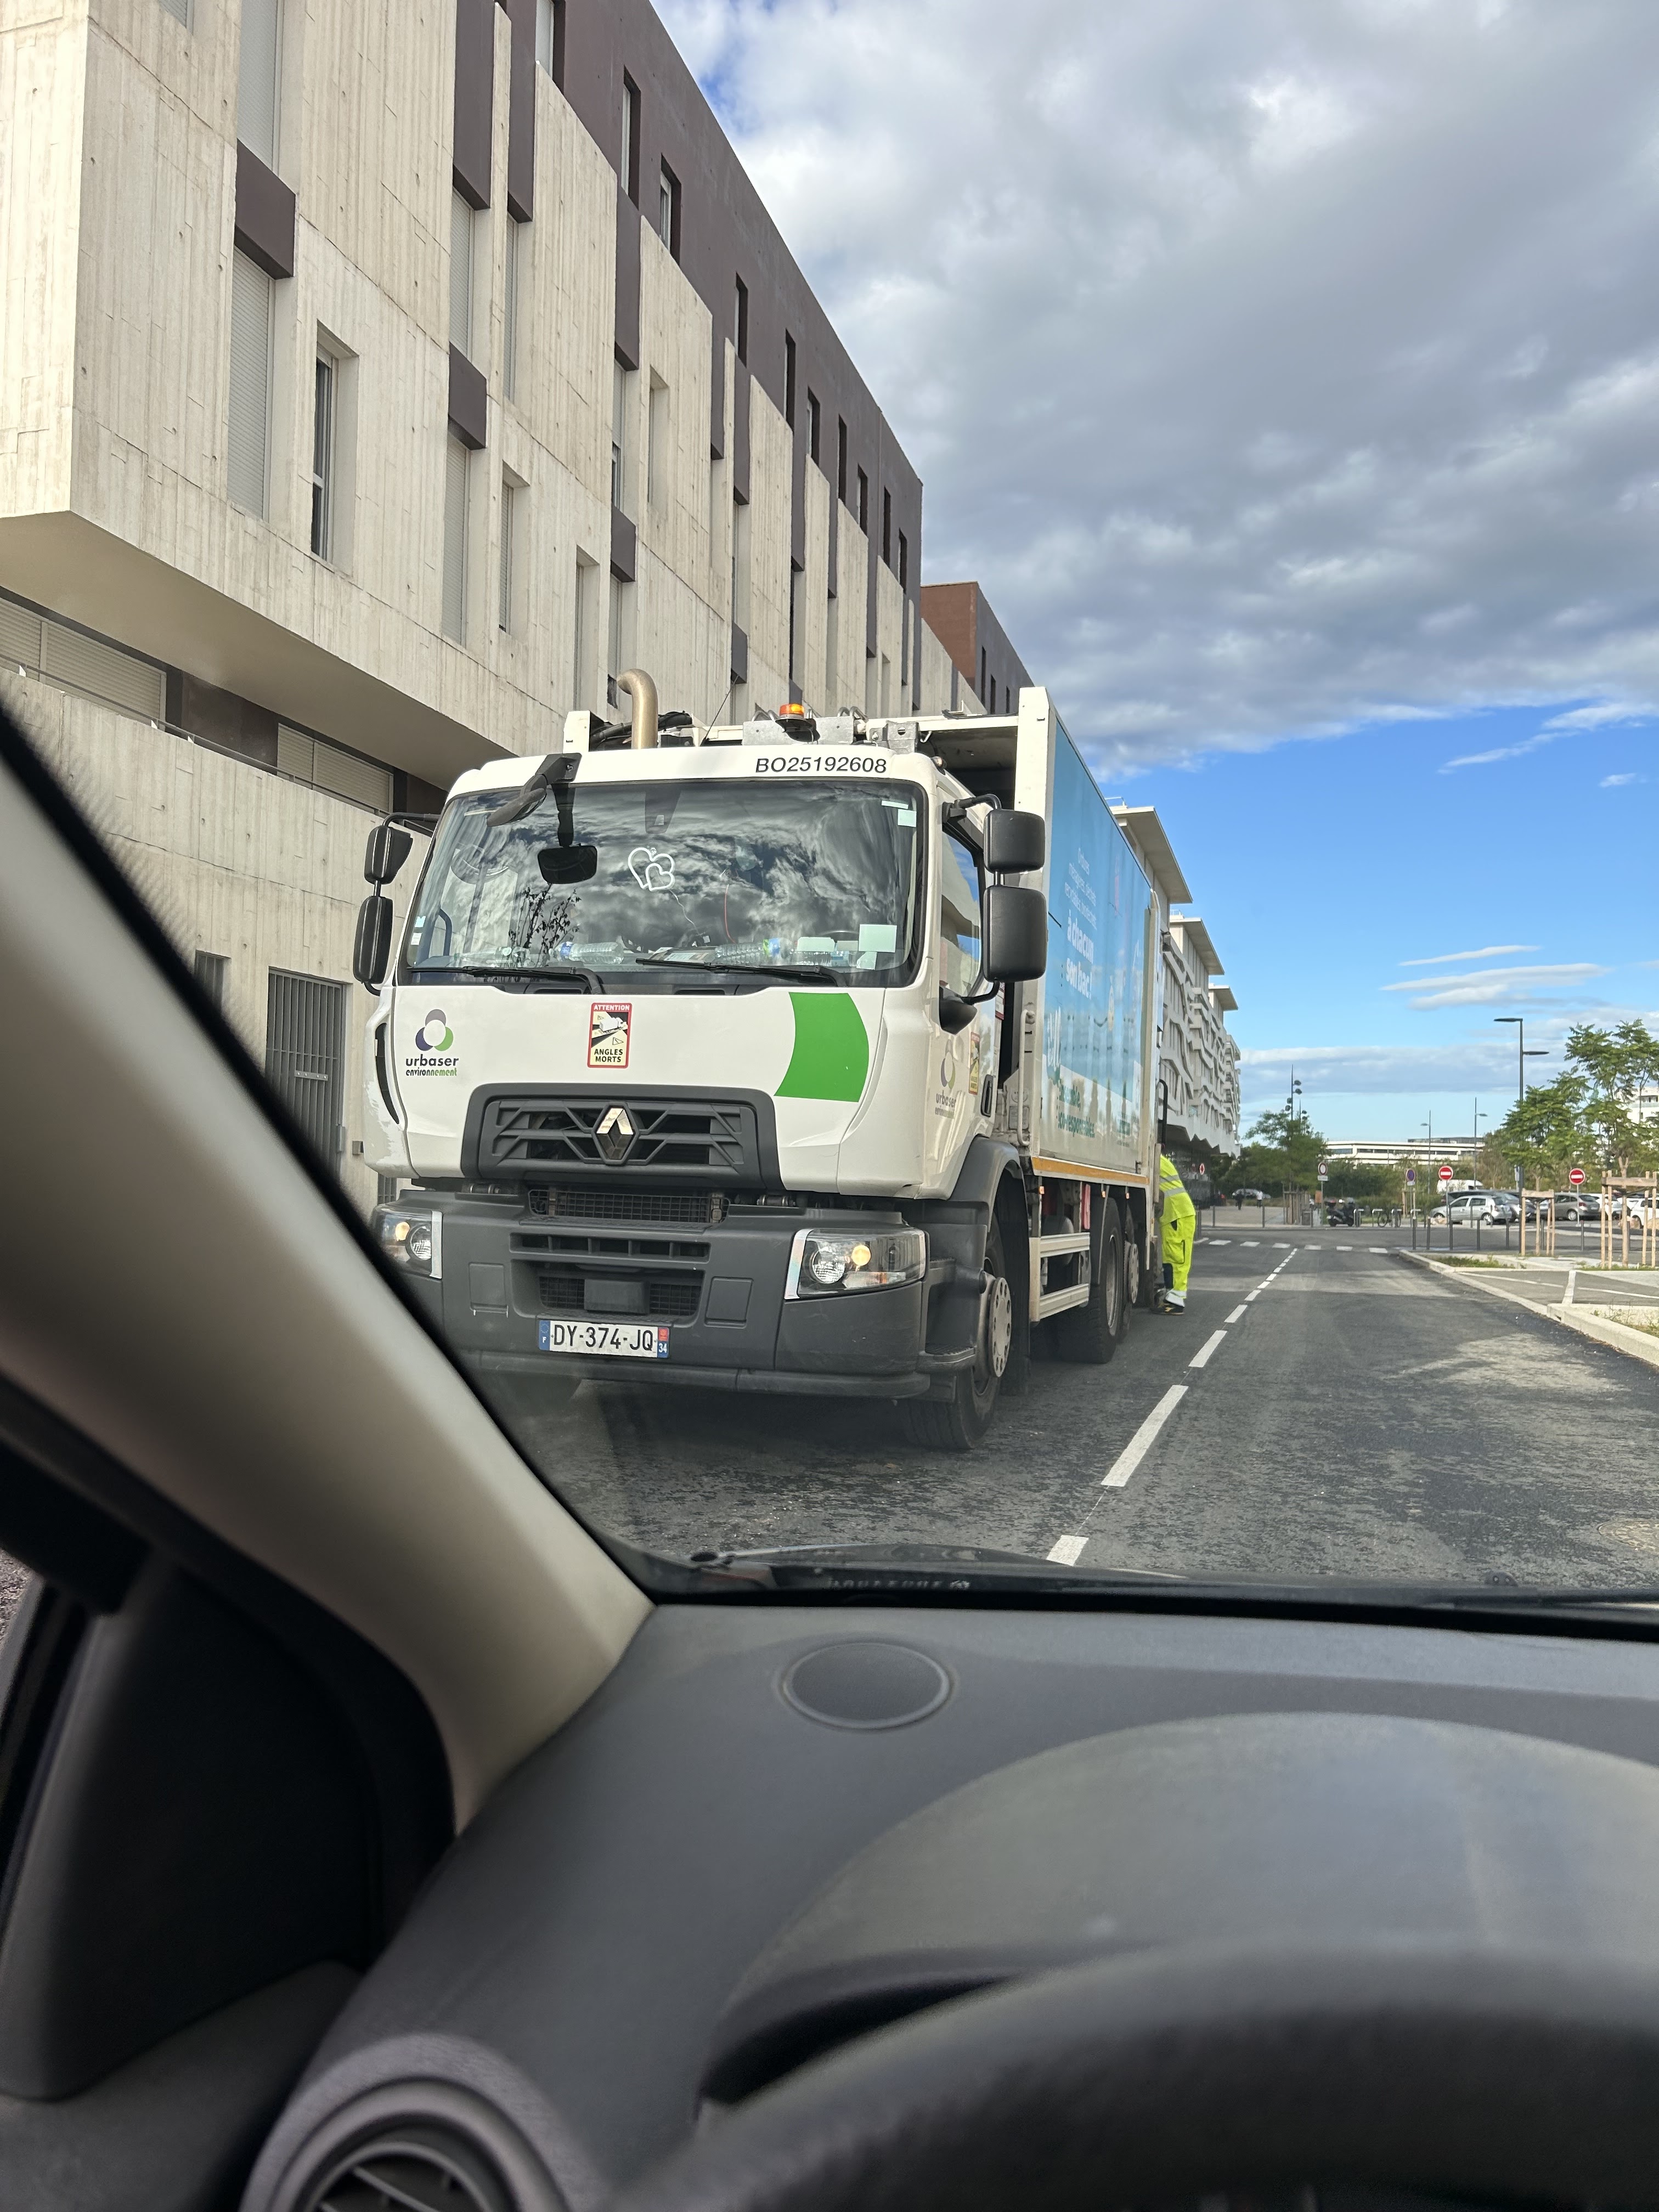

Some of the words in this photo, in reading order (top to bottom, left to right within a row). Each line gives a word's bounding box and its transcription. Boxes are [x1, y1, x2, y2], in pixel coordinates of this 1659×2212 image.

[755, 757, 887, 774] BO25192608
[1072, 917, 1094, 964] chacun
[405, 1053, 459, 1066] urbaser
[405, 1066, 457, 1076] environnement
[935, 1090, 956, 1109] urbaser
[554, 1324, 654, 1351] DY-374-JQ
[658, 1342, 667, 1353] 34
